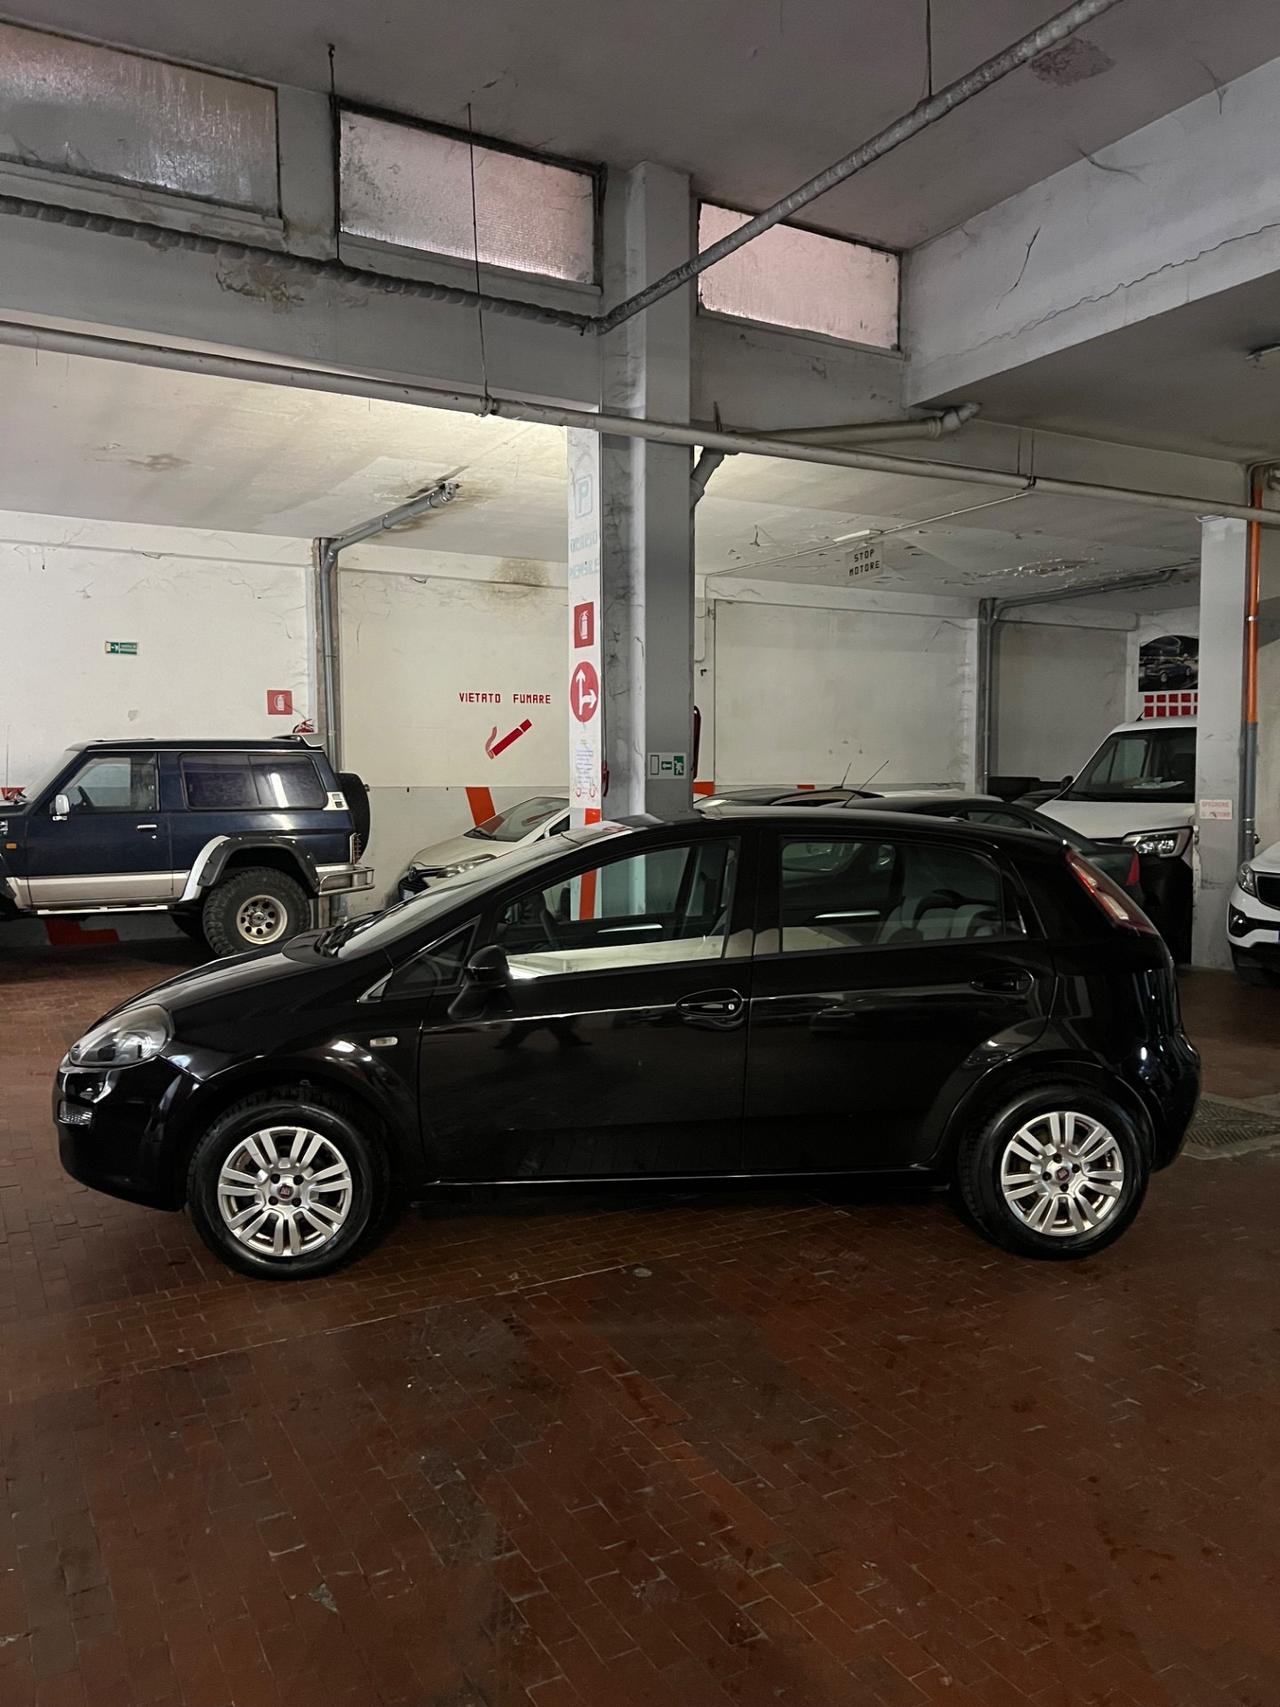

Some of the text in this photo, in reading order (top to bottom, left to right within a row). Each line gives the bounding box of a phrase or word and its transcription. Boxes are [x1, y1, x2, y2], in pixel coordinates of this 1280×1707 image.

[854, 549, 875, 562] STOP
[849, 560, 880, 577] MOTORE
[459, 692, 551, 704] VIETATO FUMARE
